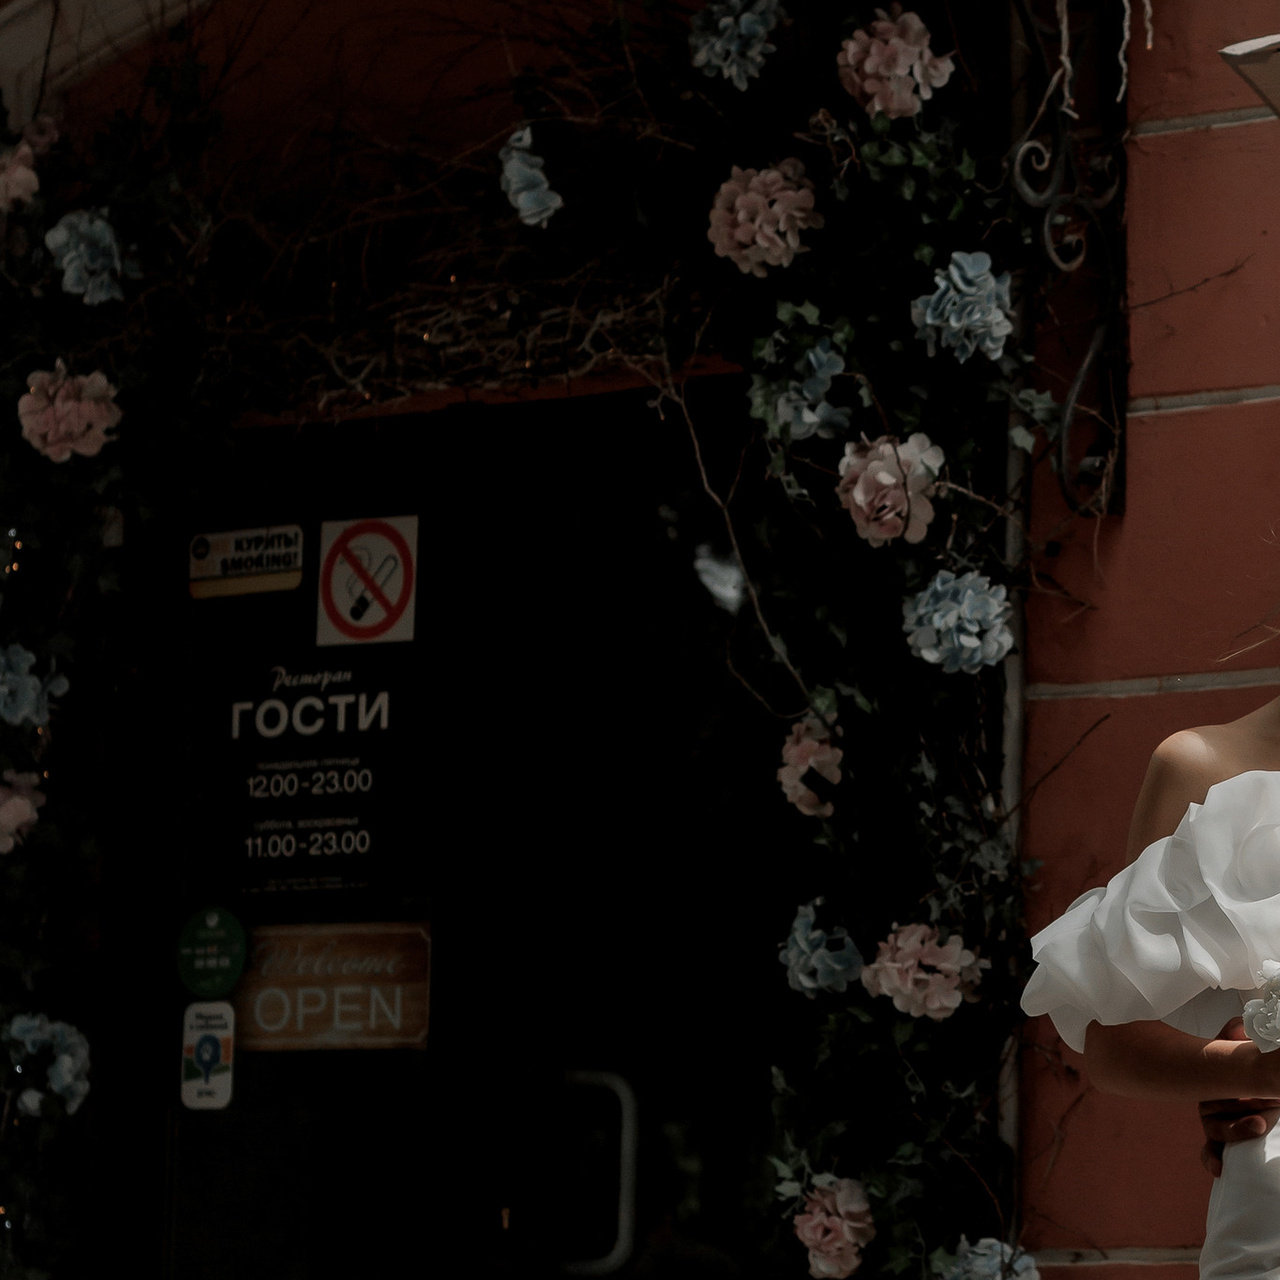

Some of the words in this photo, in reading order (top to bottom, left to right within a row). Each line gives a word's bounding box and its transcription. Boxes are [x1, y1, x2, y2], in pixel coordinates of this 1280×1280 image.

[270, 665, 353, 693] Ресторан
[230, 690, 391, 740] ГОСТИ
[253, 984, 402, 1032] OPEN
